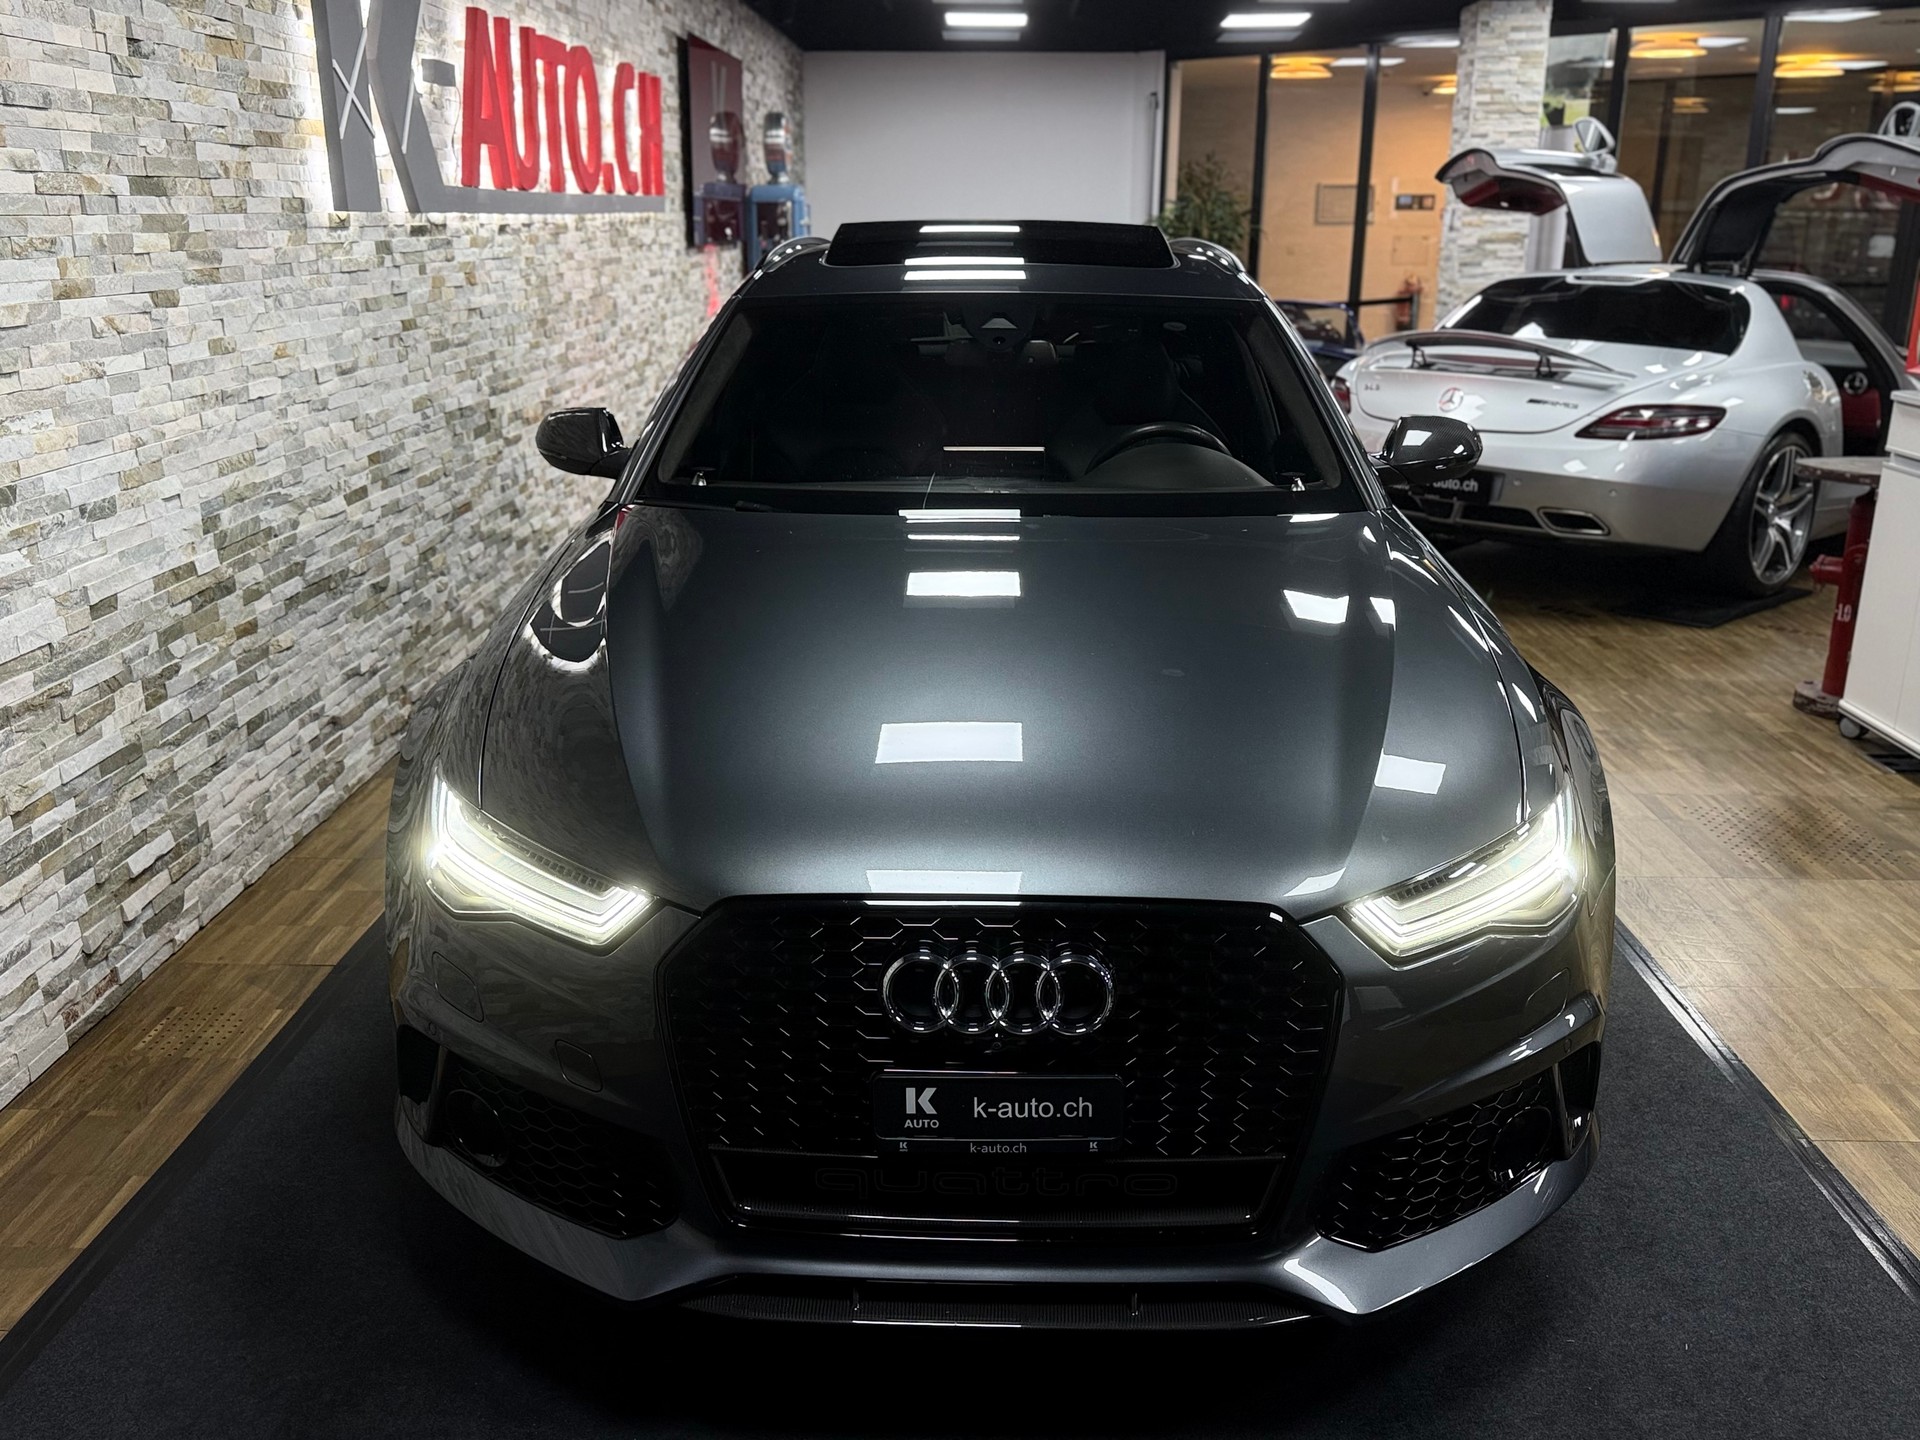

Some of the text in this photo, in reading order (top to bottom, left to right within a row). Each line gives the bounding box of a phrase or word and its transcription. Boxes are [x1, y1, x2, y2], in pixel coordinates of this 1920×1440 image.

[905, 1087, 938, 1115] K
[973, 1096, 1093, 1118] k-auto.ch
[904, 1119, 940, 1129] AUTO
[970, 1142, 1027, 1153] k-auto.ch
[814, 1165, 1179, 1200] quattro
